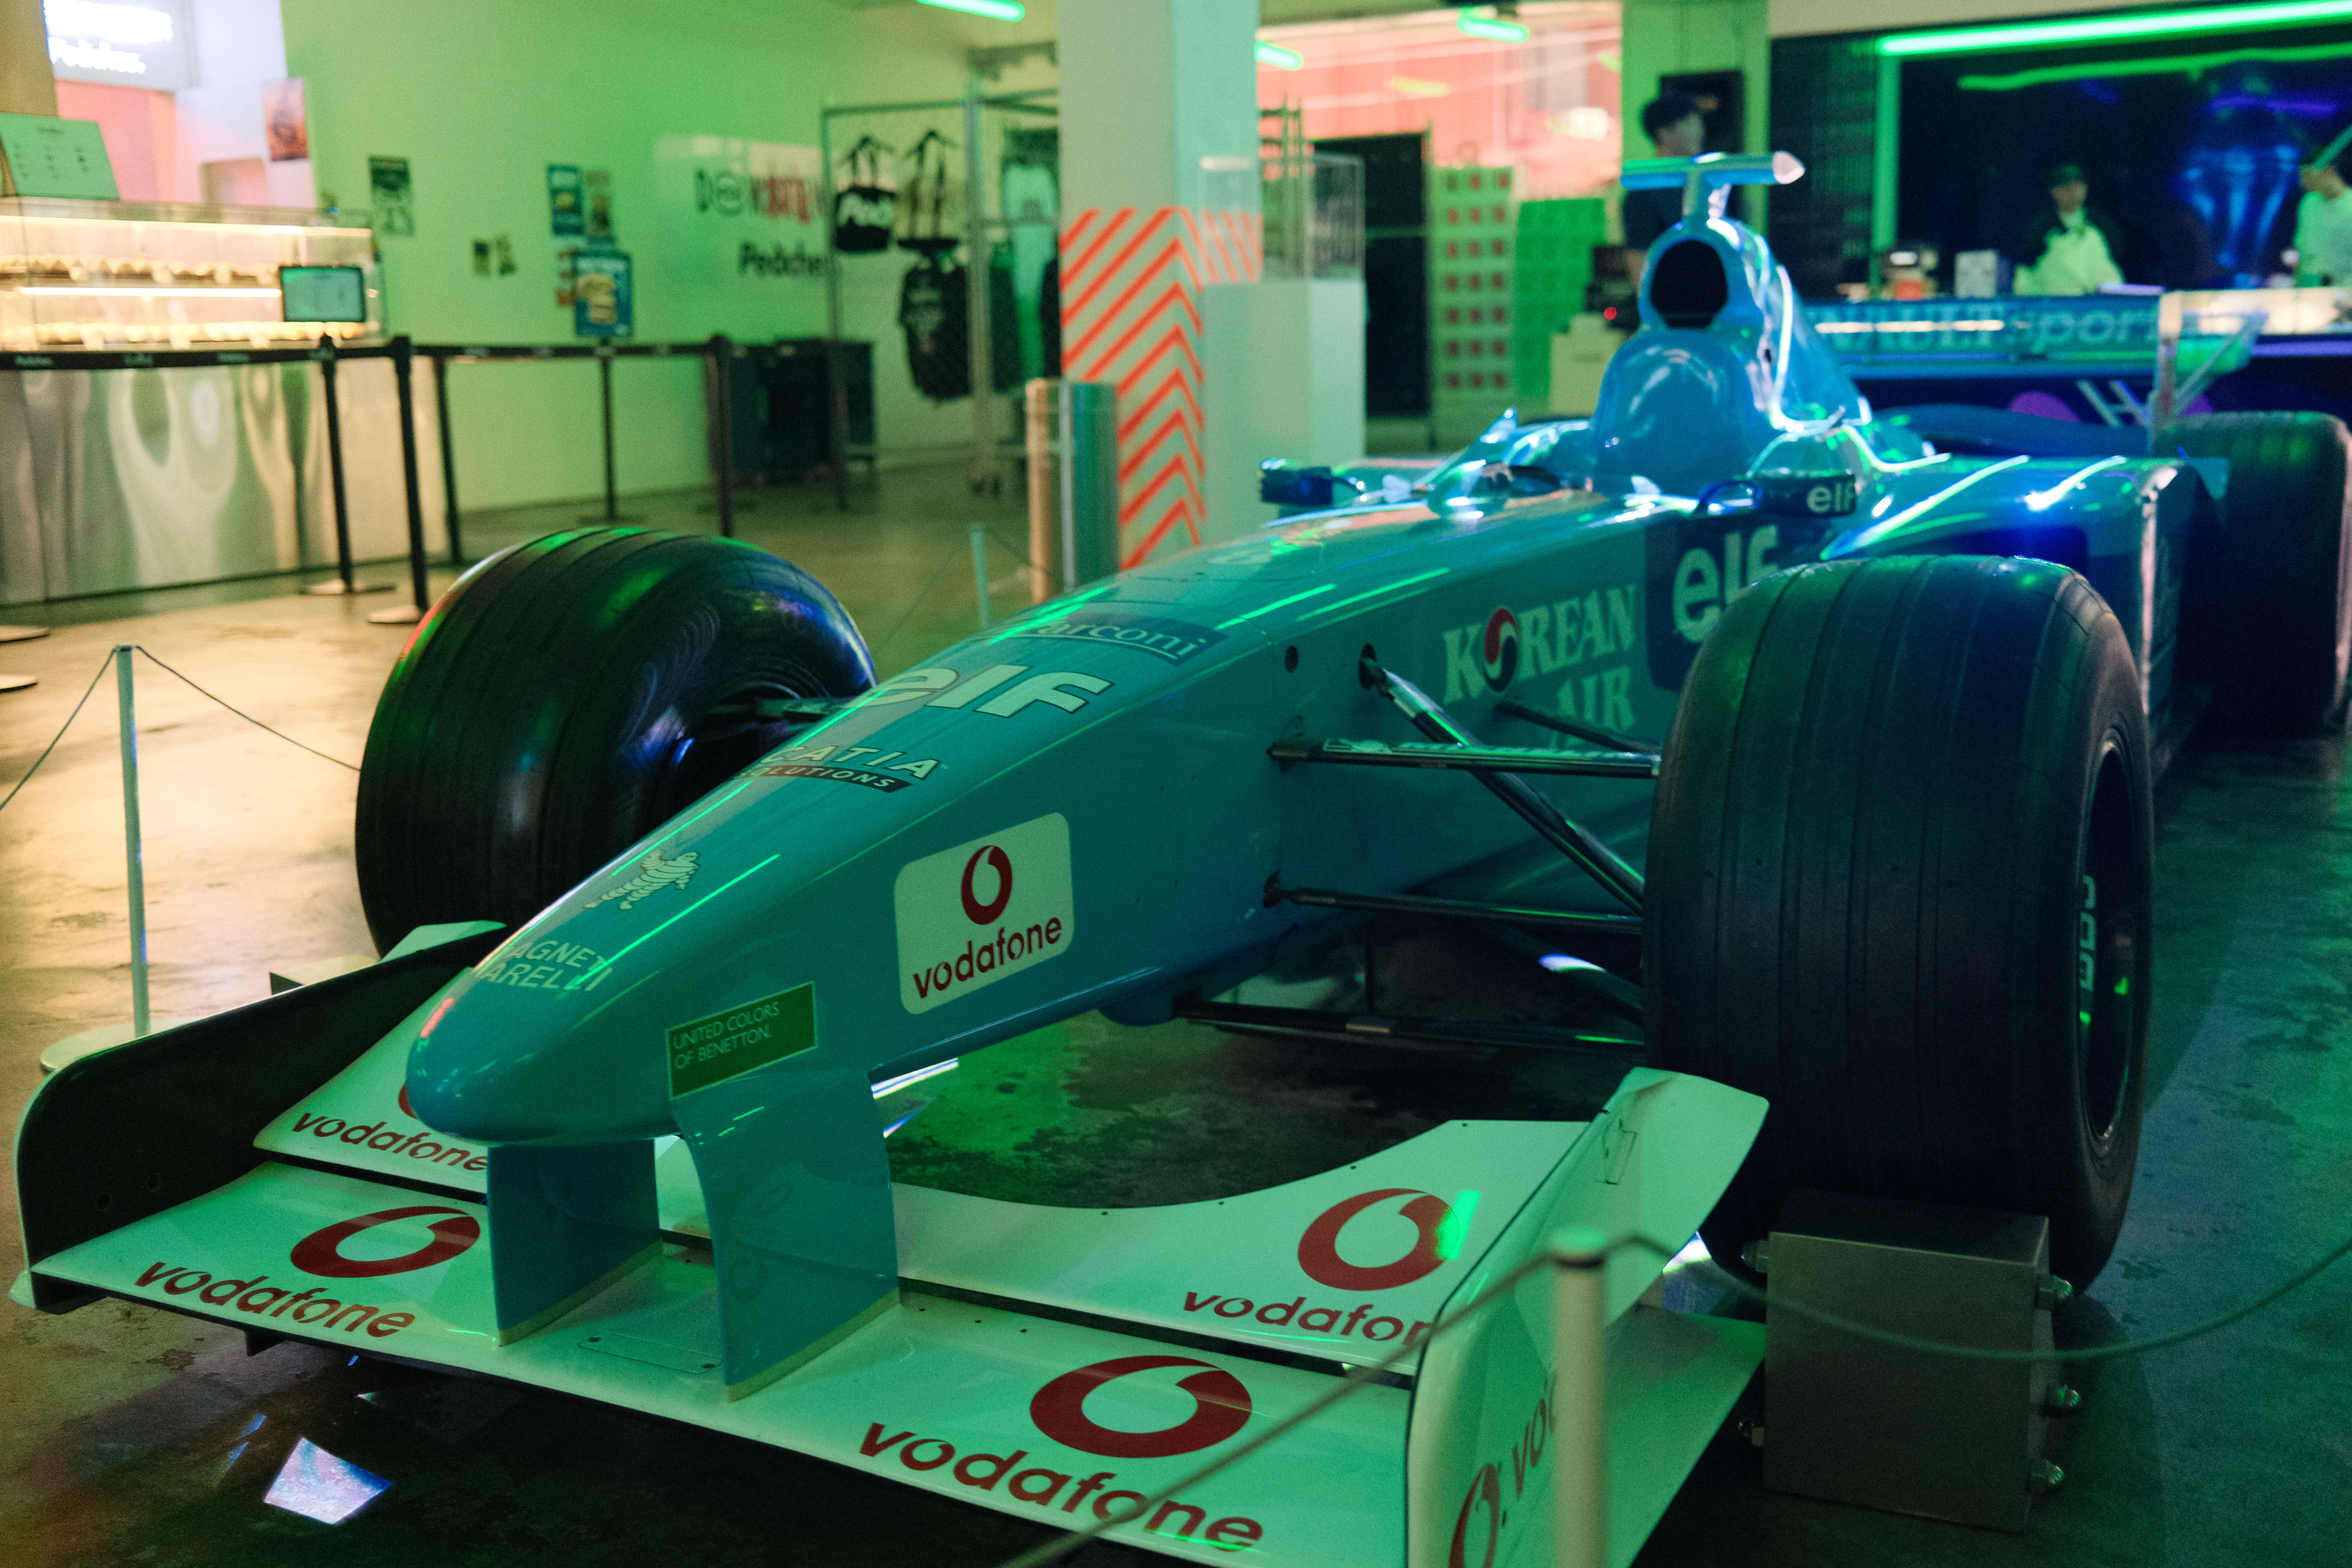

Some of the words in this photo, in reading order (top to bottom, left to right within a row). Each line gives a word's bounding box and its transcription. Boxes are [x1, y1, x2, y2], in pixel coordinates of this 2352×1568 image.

[1806, 481, 1856, 514] elf
[1673, 525, 1778, 644] elf
[1035, 621, 1206, 657] arconi
[1442, 584, 1637, 704] KOREAN
[845, 664, 1114, 718] elf
[912, 917, 1063, 999] vodafone
[674, 1021, 724, 1049] UNITED
[727, 1002, 780, 1031] COLORS
[675, 1050, 694, 1069] OF
[292, 1113, 487, 1171] vodafone
[134, 1261, 415, 1338] vodafone
[1183, 1291, 1433, 1346] vodafo
[859, 1421, 1264, 1553] vodafone
